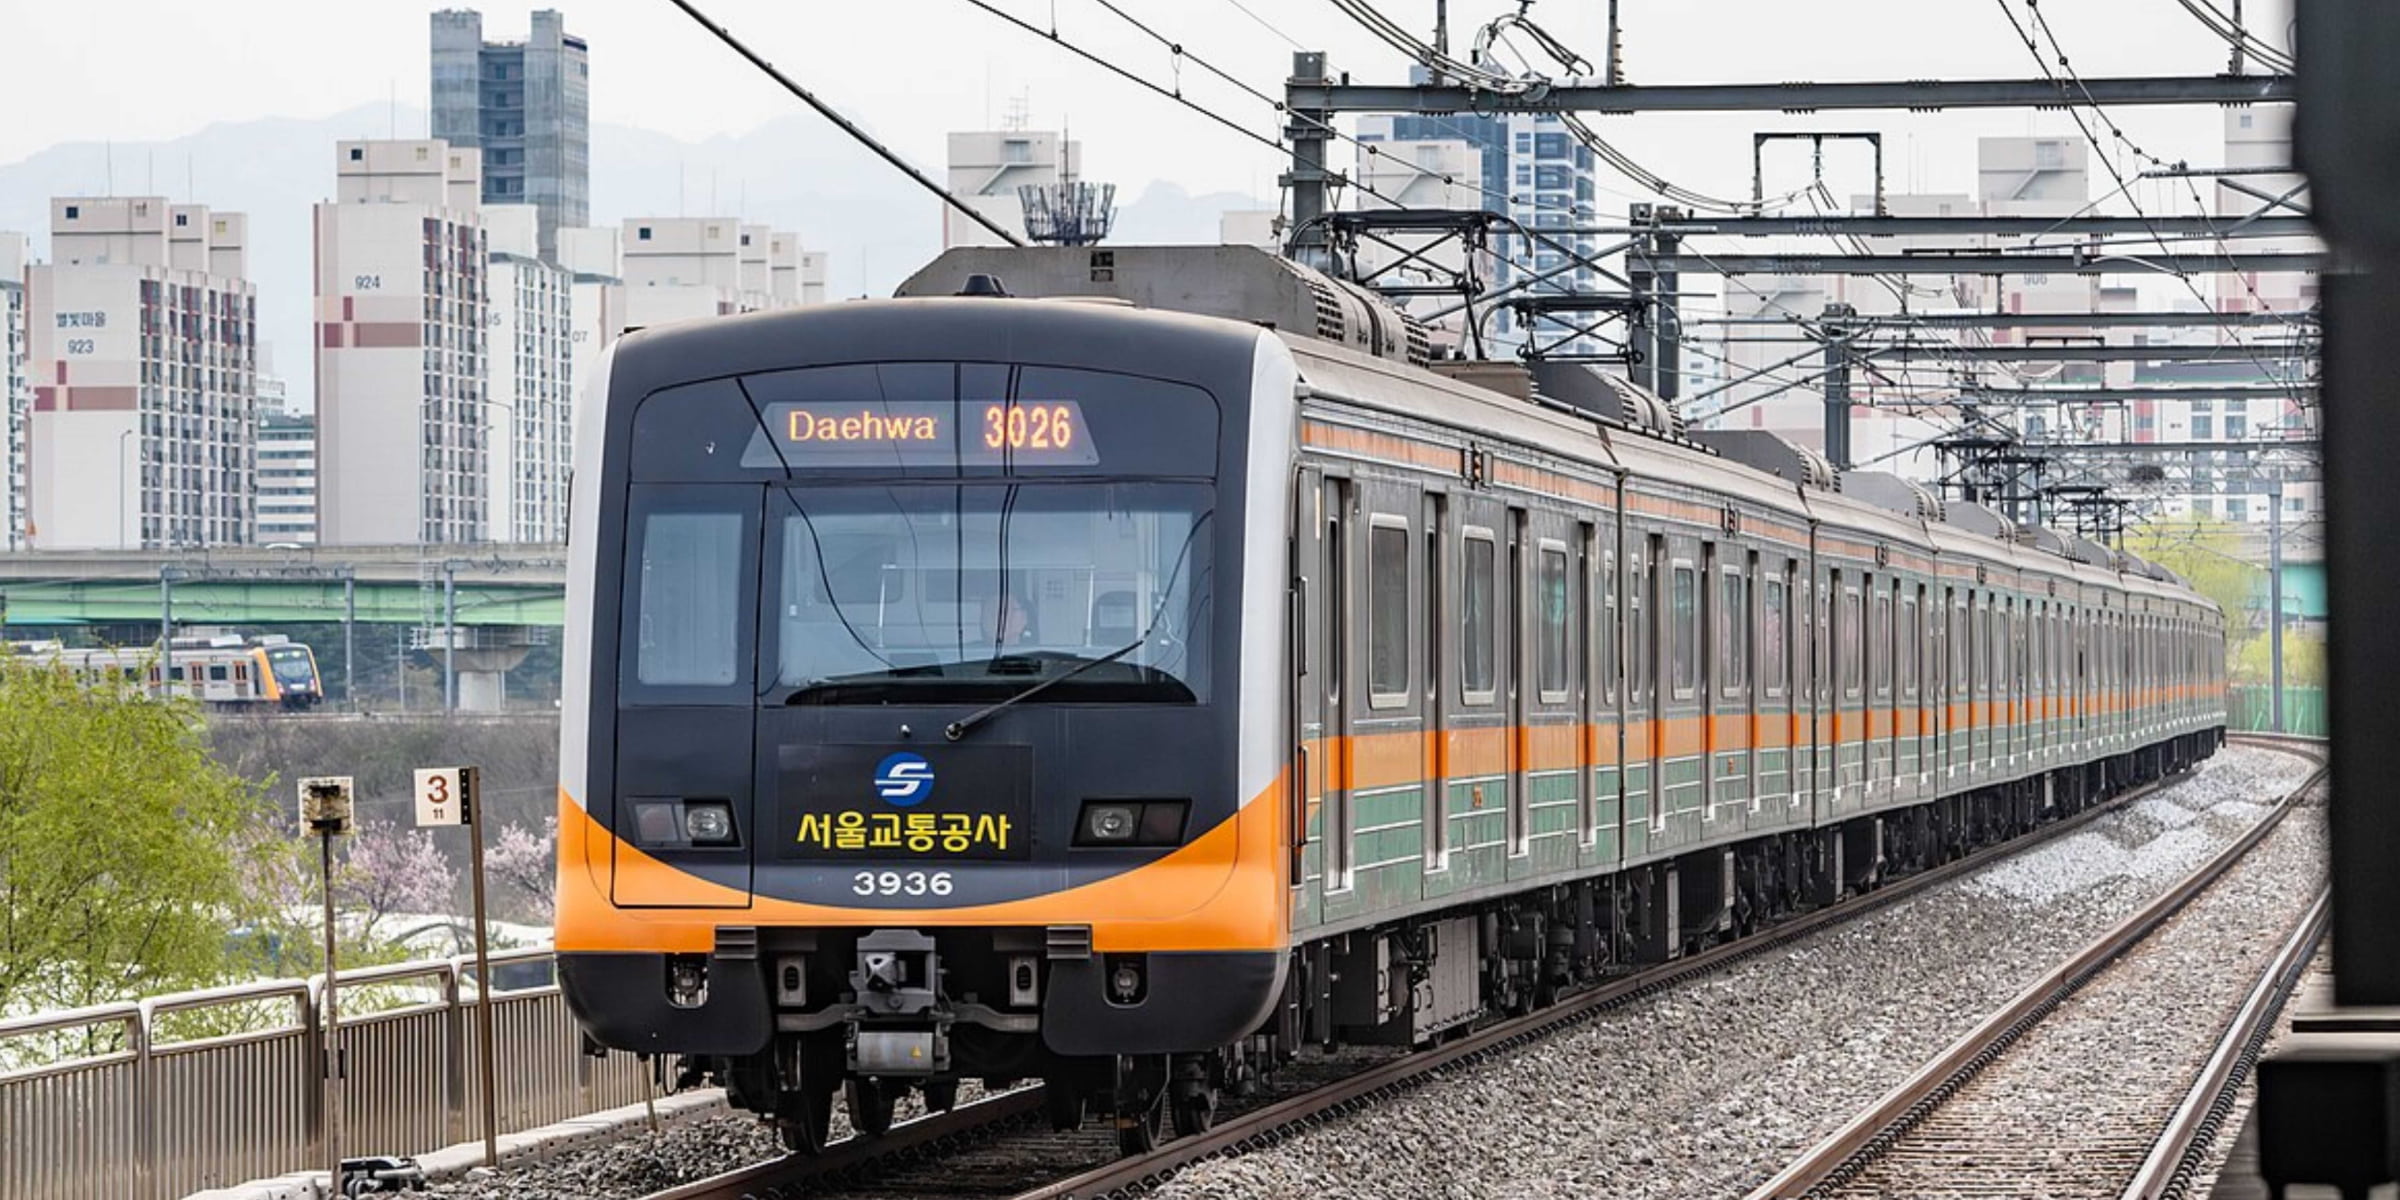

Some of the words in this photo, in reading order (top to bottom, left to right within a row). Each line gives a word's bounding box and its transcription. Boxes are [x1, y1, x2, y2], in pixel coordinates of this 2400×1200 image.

[355, 275, 380, 289] 924
[56, 311, 106, 327] 별빛마을
[68, 339, 94, 354] 923
[788, 410, 937, 441] Daehwa
[984, 406, 1072, 447] 3026
[428, 775, 449, 803] 3
[432, 808, 444, 820] 11
[797, 811, 1011, 852] 서울교통공사
[853, 871, 953, 896] 3936
